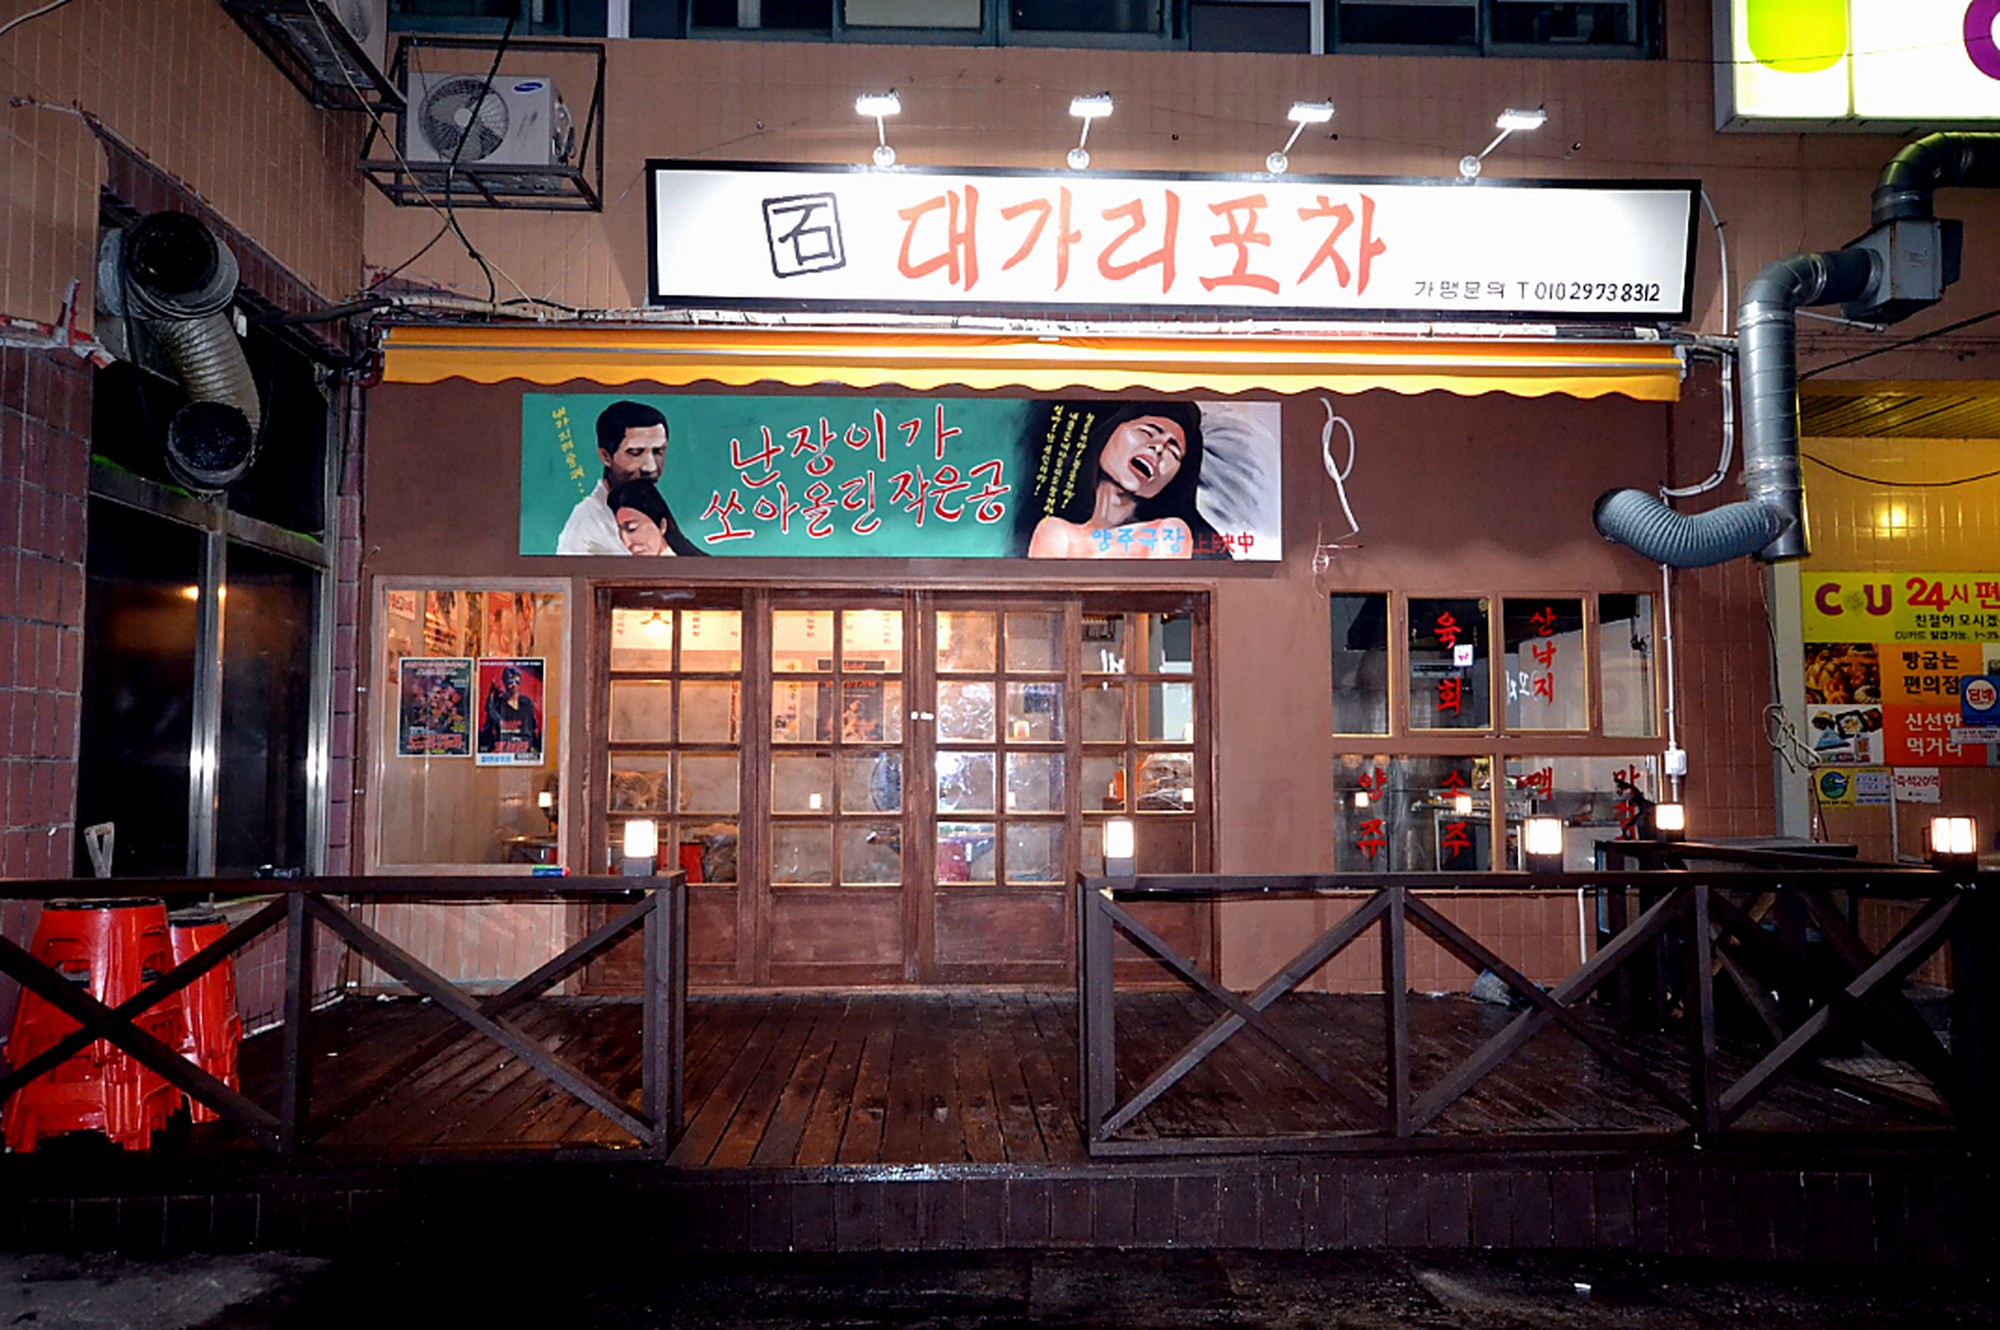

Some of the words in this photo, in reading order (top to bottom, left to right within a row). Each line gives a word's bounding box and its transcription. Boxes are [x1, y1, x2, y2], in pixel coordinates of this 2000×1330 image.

[896, 182, 1389, 294] 대가리포차
[1414, 280, 1506, 300] 가맹문의
[730, 403, 962, 487] 난장이가
[703, 469, 881, 543] 쏘아올린
[888, 458, 1012, 527] 작은공
[1091, 527, 1186, 554] 양주극장
[1814, 582, 1893, 617] CU
[1905, 577, 1969, 612] 24시
[1959, 614, 1999, 628] 모시겠
[1433, 611, 1462, 717] 육회
[1529, 606, 1557, 704] 산낙지
[1902, 651, 1960, 670] 빵굽는
[1903, 675, 1960, 695] 편의점
[1358, 767, 1387, 859] 양주
[1441, 770, 1471, 858] 소주
